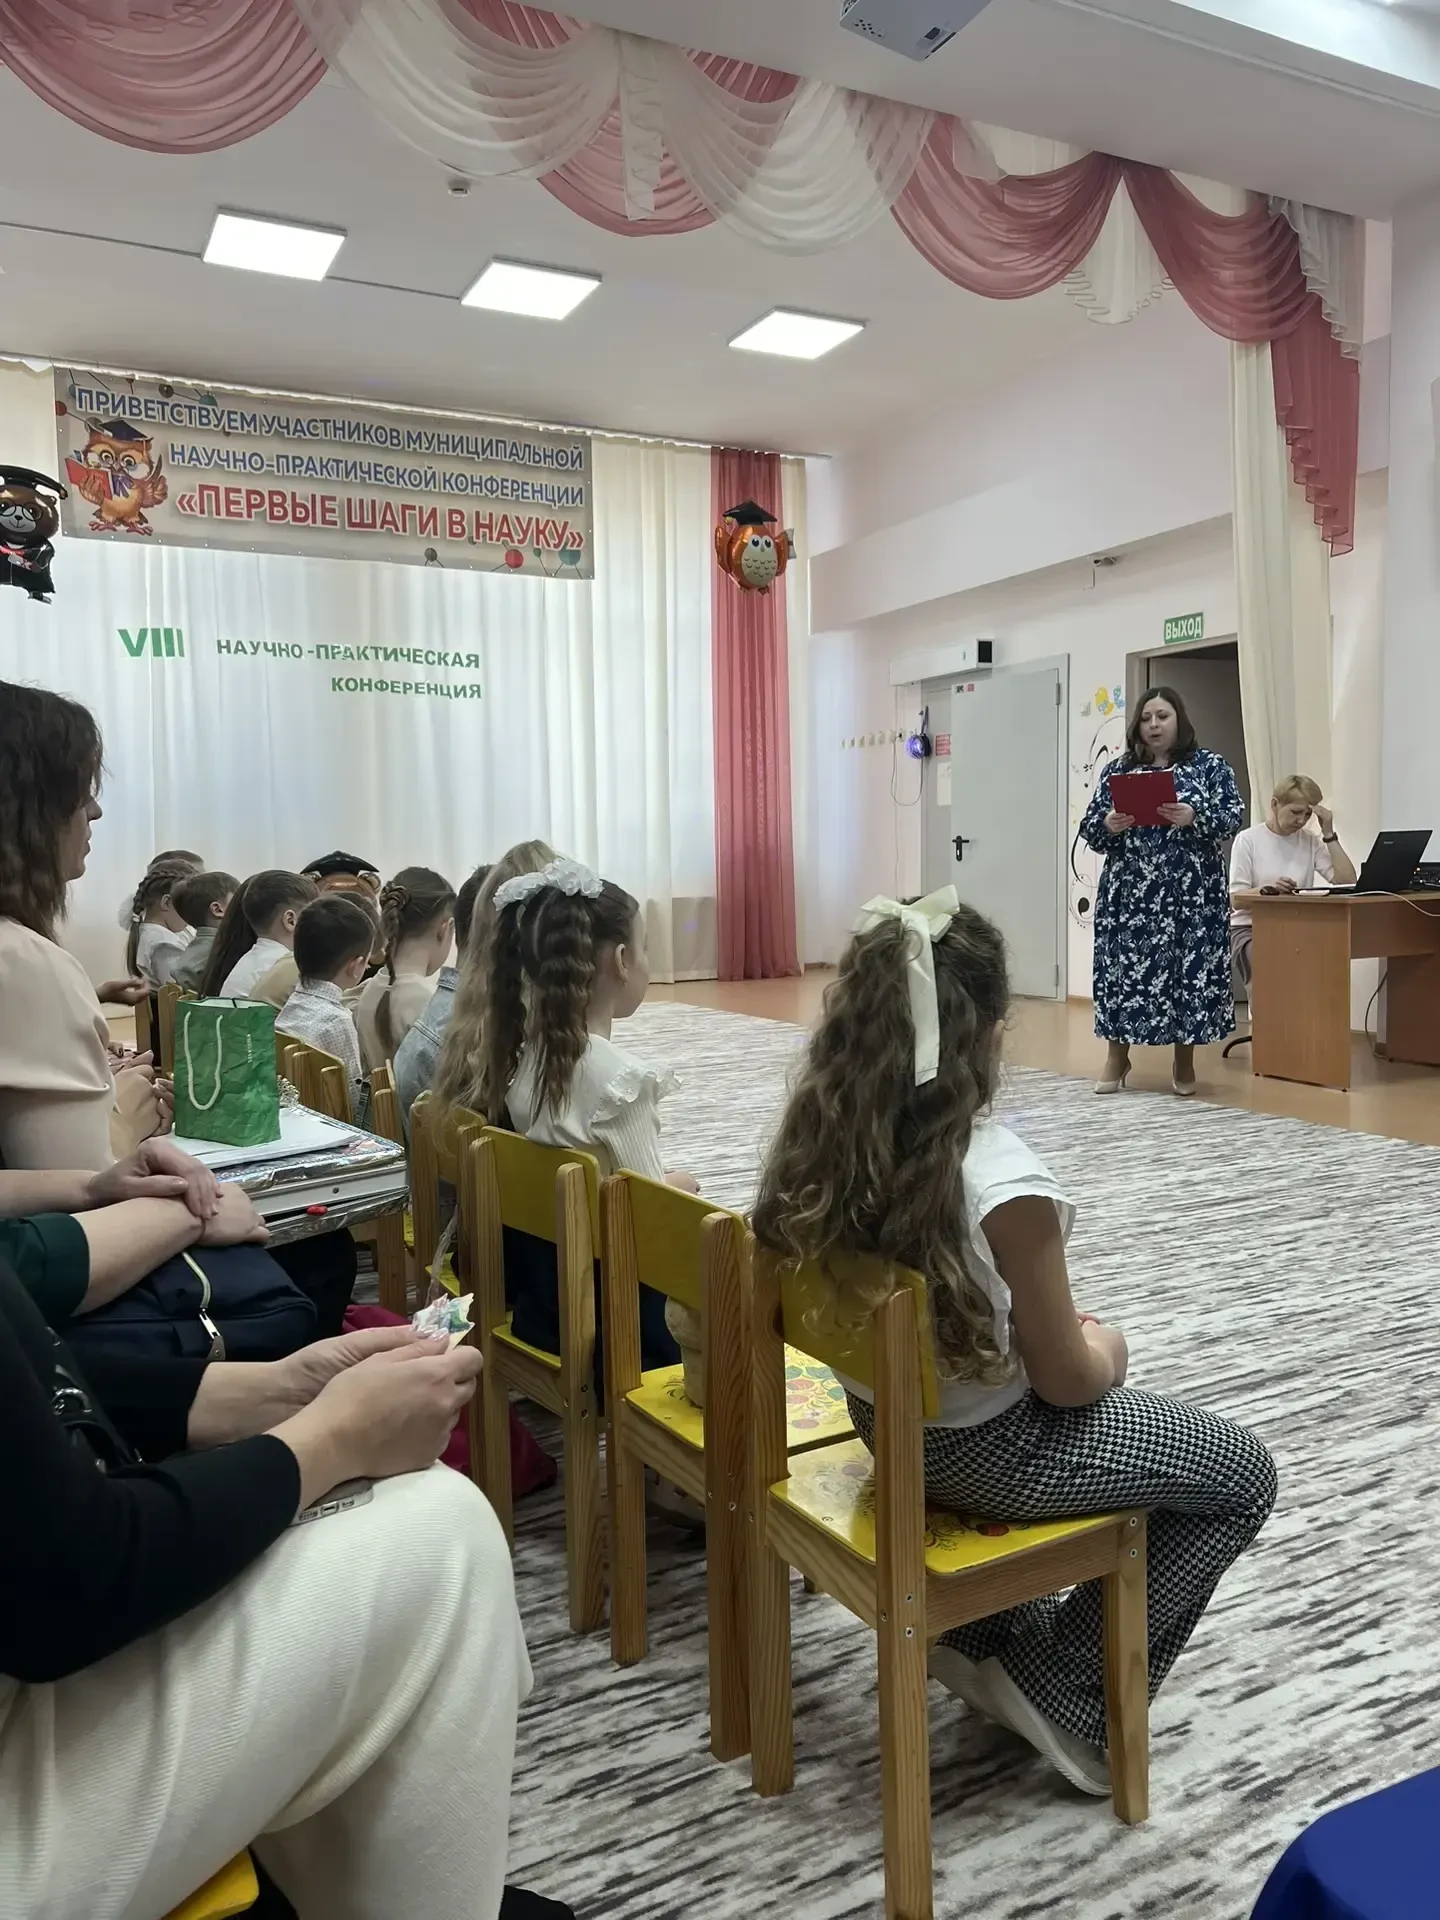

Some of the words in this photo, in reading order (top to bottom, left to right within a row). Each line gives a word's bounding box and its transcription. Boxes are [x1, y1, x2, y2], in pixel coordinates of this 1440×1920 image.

[76, 387, 258, 433] ПРИВЕТСТВУЕМ
[264, 414, 401, 447] УЧАСТНИКОВ
[407, 430, 583, 469] МУНИЦИПАЛЬНОЙ
[169, 443, 437, 489] НАУЧНО-ПРАКТИЧЕСКОЙ
[443, 472, 584, 507] КОНФЕРЕНЦИИ
[178, 484, 338, 526] «ПЕРВЫЕ
[347, 498, 439, 537] ШАГИ
[447, 508, 467, 539] В
[474, 510, 585, 549] НАУКУ»
[117, 628, 185, 657] VIII
[1165, 616, 1202, 640] ВЫХОД
[331, 677, 482, 699] КОНФЕРЕНЦИЯ
